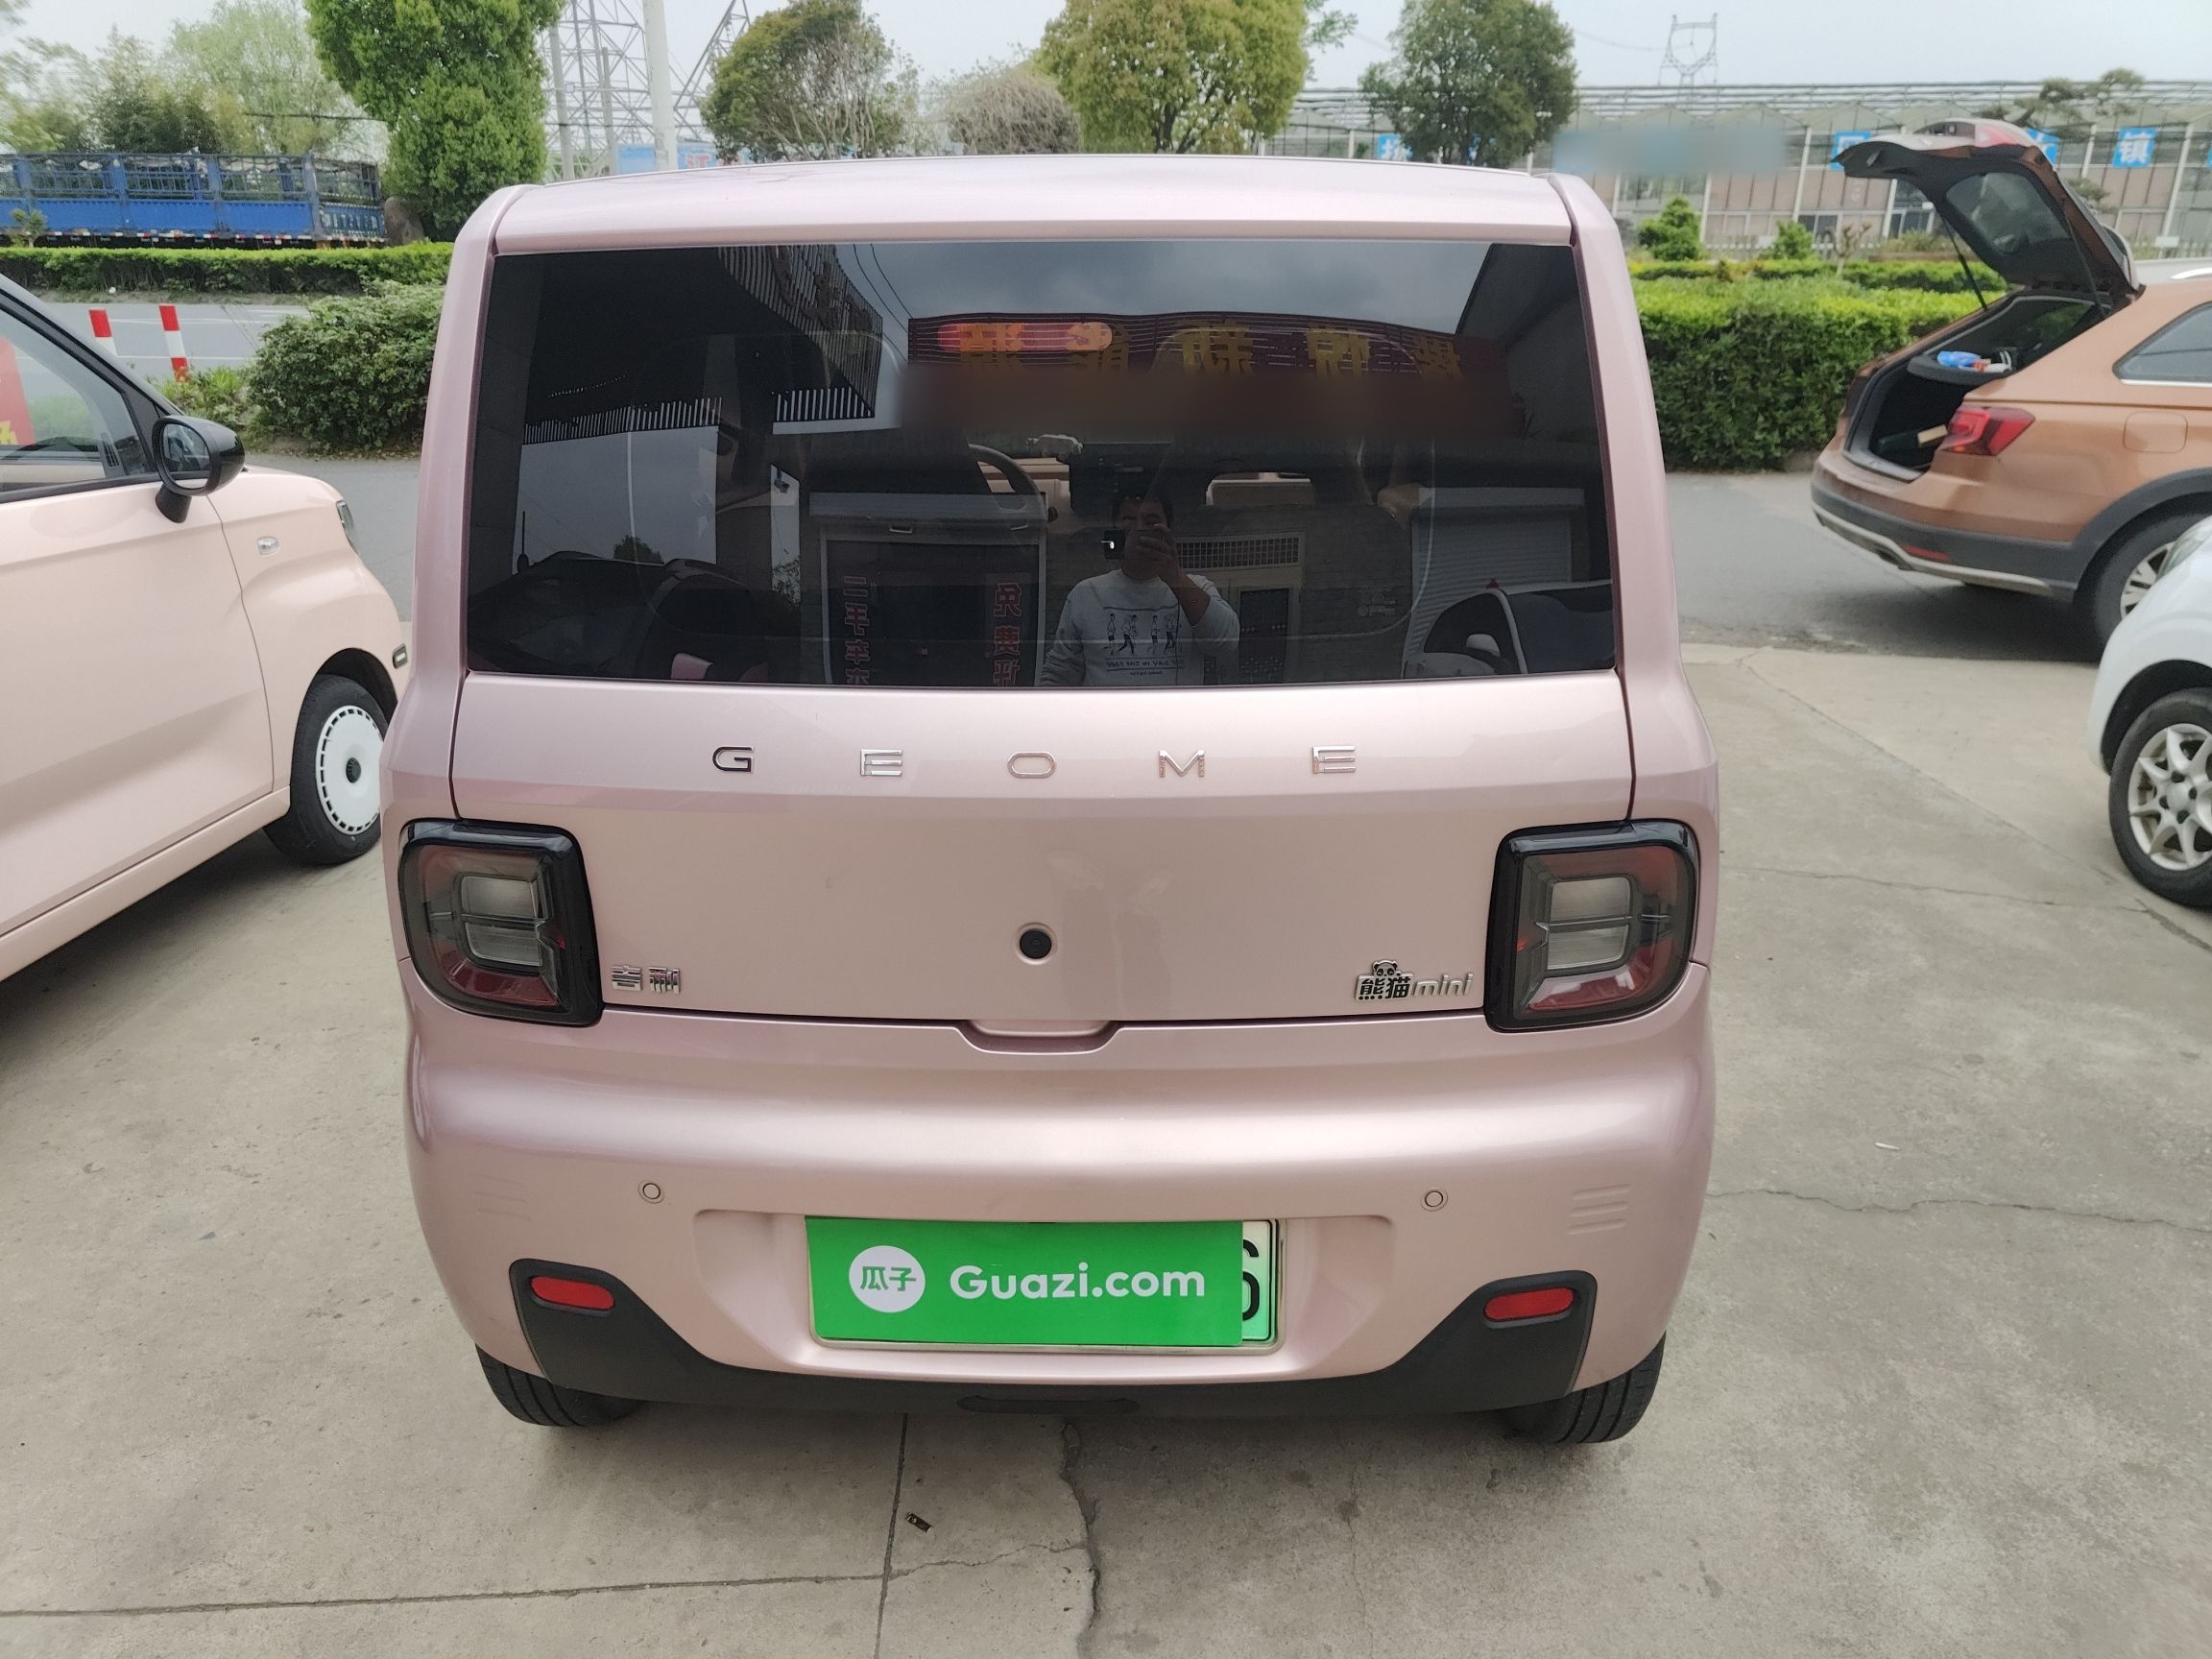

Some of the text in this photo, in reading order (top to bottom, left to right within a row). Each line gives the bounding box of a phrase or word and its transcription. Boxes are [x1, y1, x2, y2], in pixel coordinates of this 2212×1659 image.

[2119, 132, 2152, 163] 镇
[711, 745, 1357, 779] GEOME
[612, 965, 681, 994] 吉利
[1358, 973, 1474, 1000] 熊猫 mini
